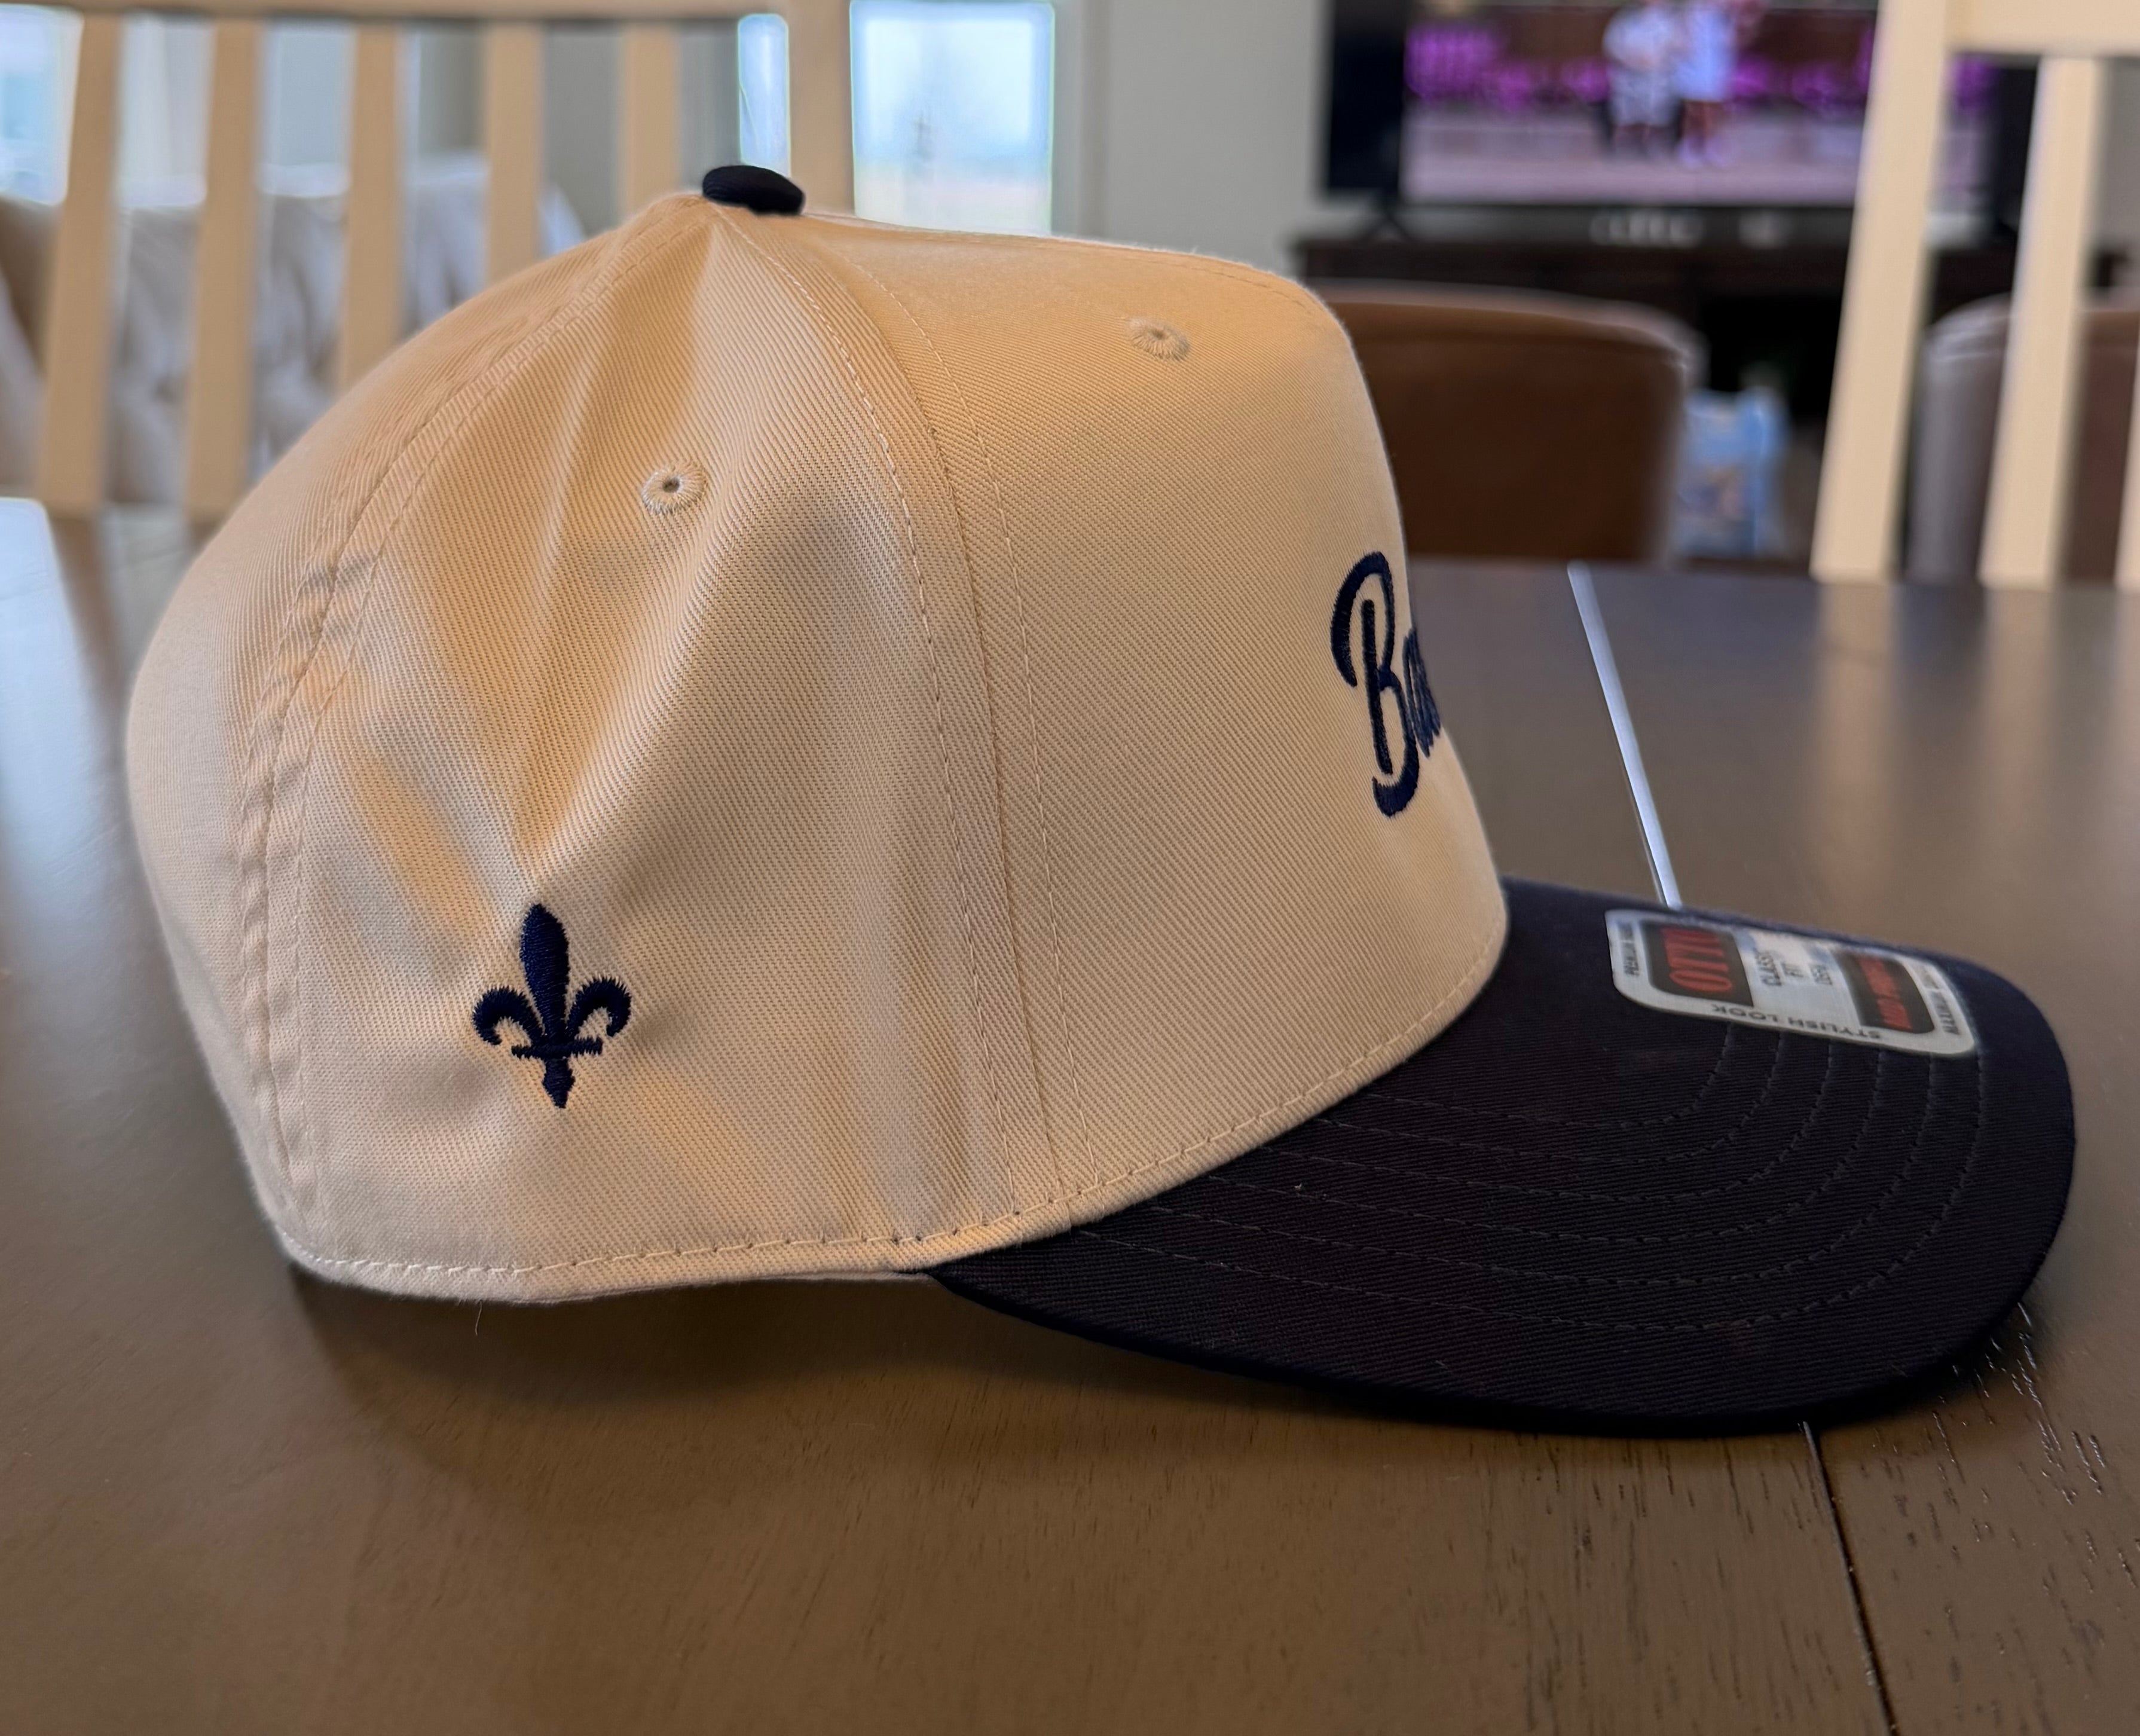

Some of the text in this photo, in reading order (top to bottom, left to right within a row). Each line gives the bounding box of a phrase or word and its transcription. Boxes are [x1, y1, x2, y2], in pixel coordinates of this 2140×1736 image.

[1754, 948, 1782, 986] CLASS
[1711, 1004, 1881, 1038] STYLISH LOOK
